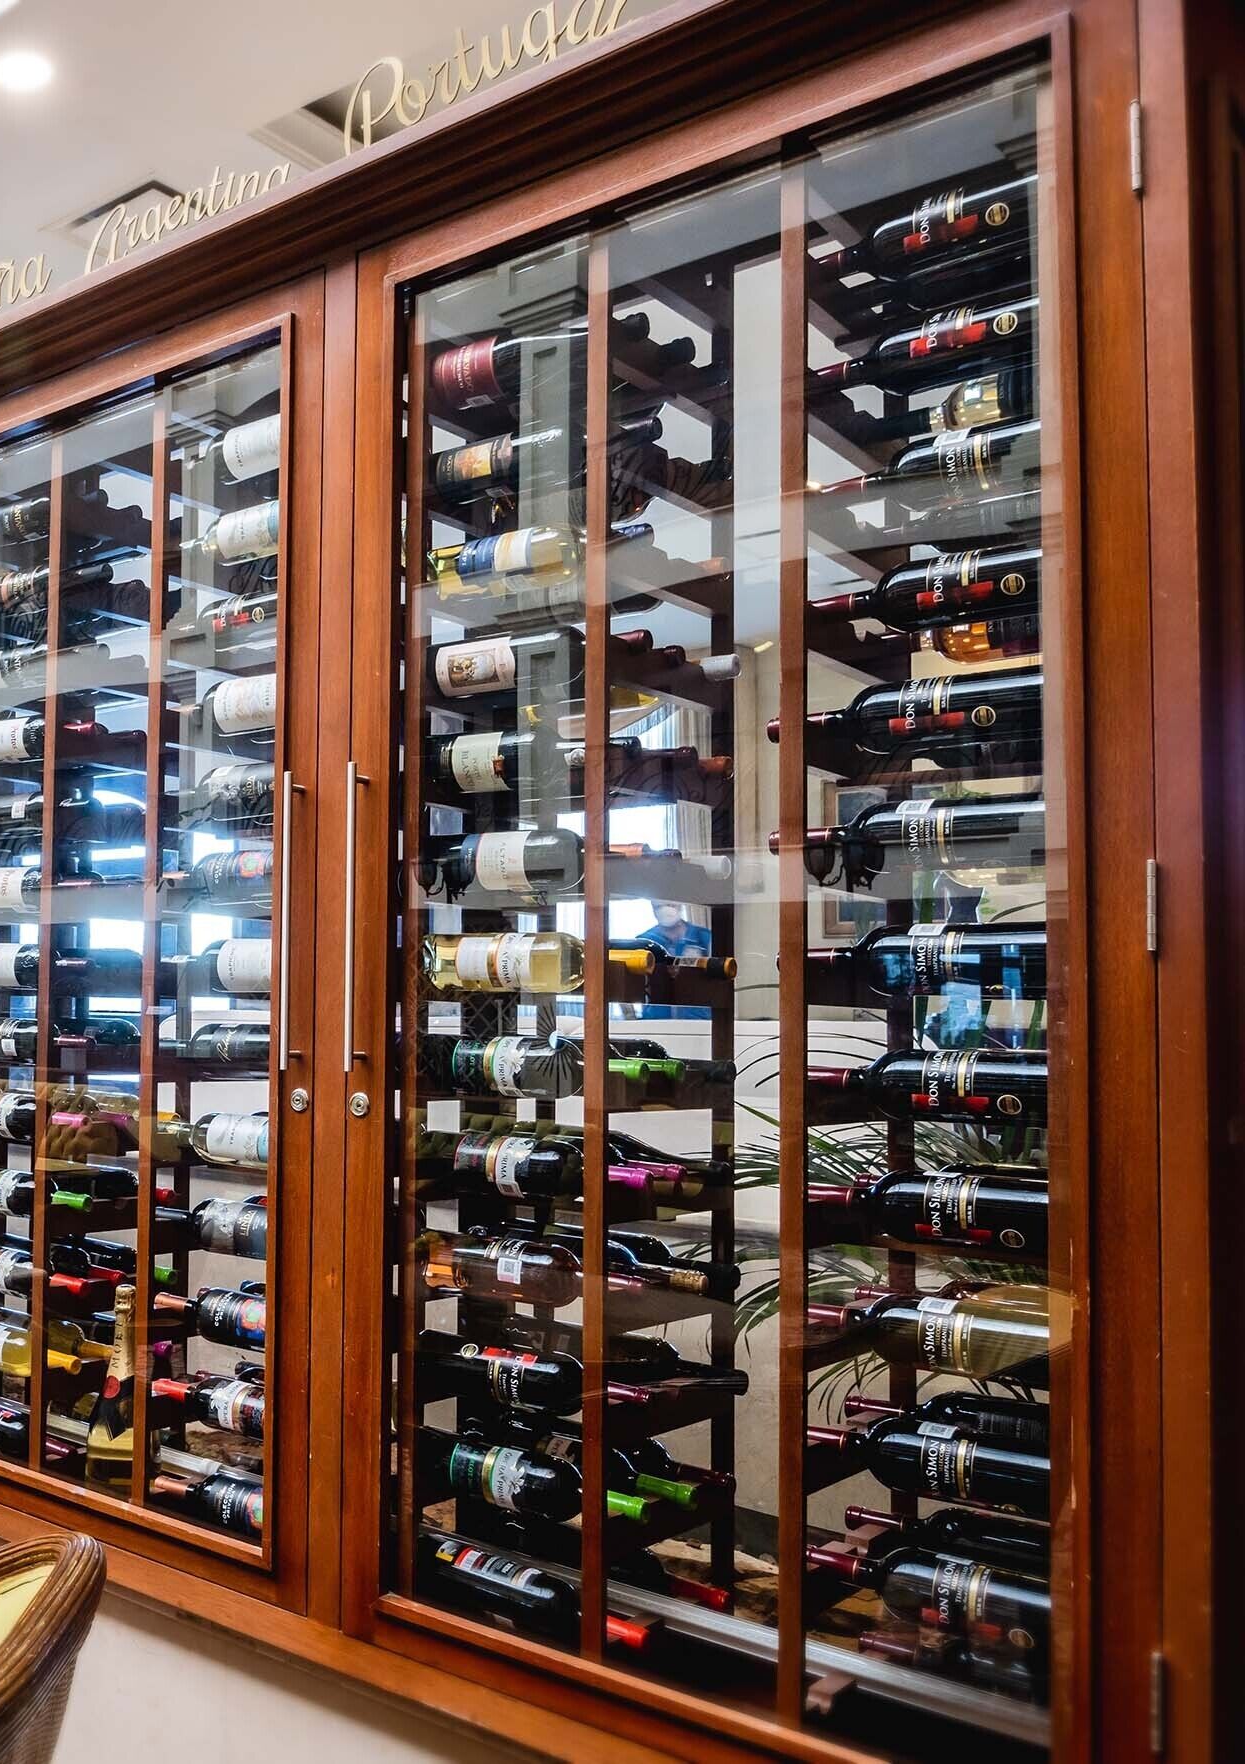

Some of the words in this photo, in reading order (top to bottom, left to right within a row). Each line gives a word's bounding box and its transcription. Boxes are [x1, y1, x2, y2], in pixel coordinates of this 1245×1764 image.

[84, 164, 291, 275] Argentina
[919, 217, 931, 245] DON
[926, 322, 937, 348] DON
[945, 446, 959, 483] SIMON
[932, 576, 944, 603] DON
[905, 702, 916, 729] DON
[908, 816, 920, 853] SIMON
[915, 937, 928, 973] SIMON
[501, 958, 512, 984] PRIMA
[497, 1062, 509, 1088] PRIMA
[927, 1080, 940, 1107] DON
[928, 1176, 947, 1209] SIMON
[239, 1209, 255, 1237] LINDA
[931, 1211, 944, 1237] DON
[923, 1314, 937, 1352] SIMON
[511, 1354, 524, 1377] DON
[925, 1440, 940, 1478] SIMON
[937, 1561, 957, 1596] SIMON
[938, 1597, 950, 1625] DON
